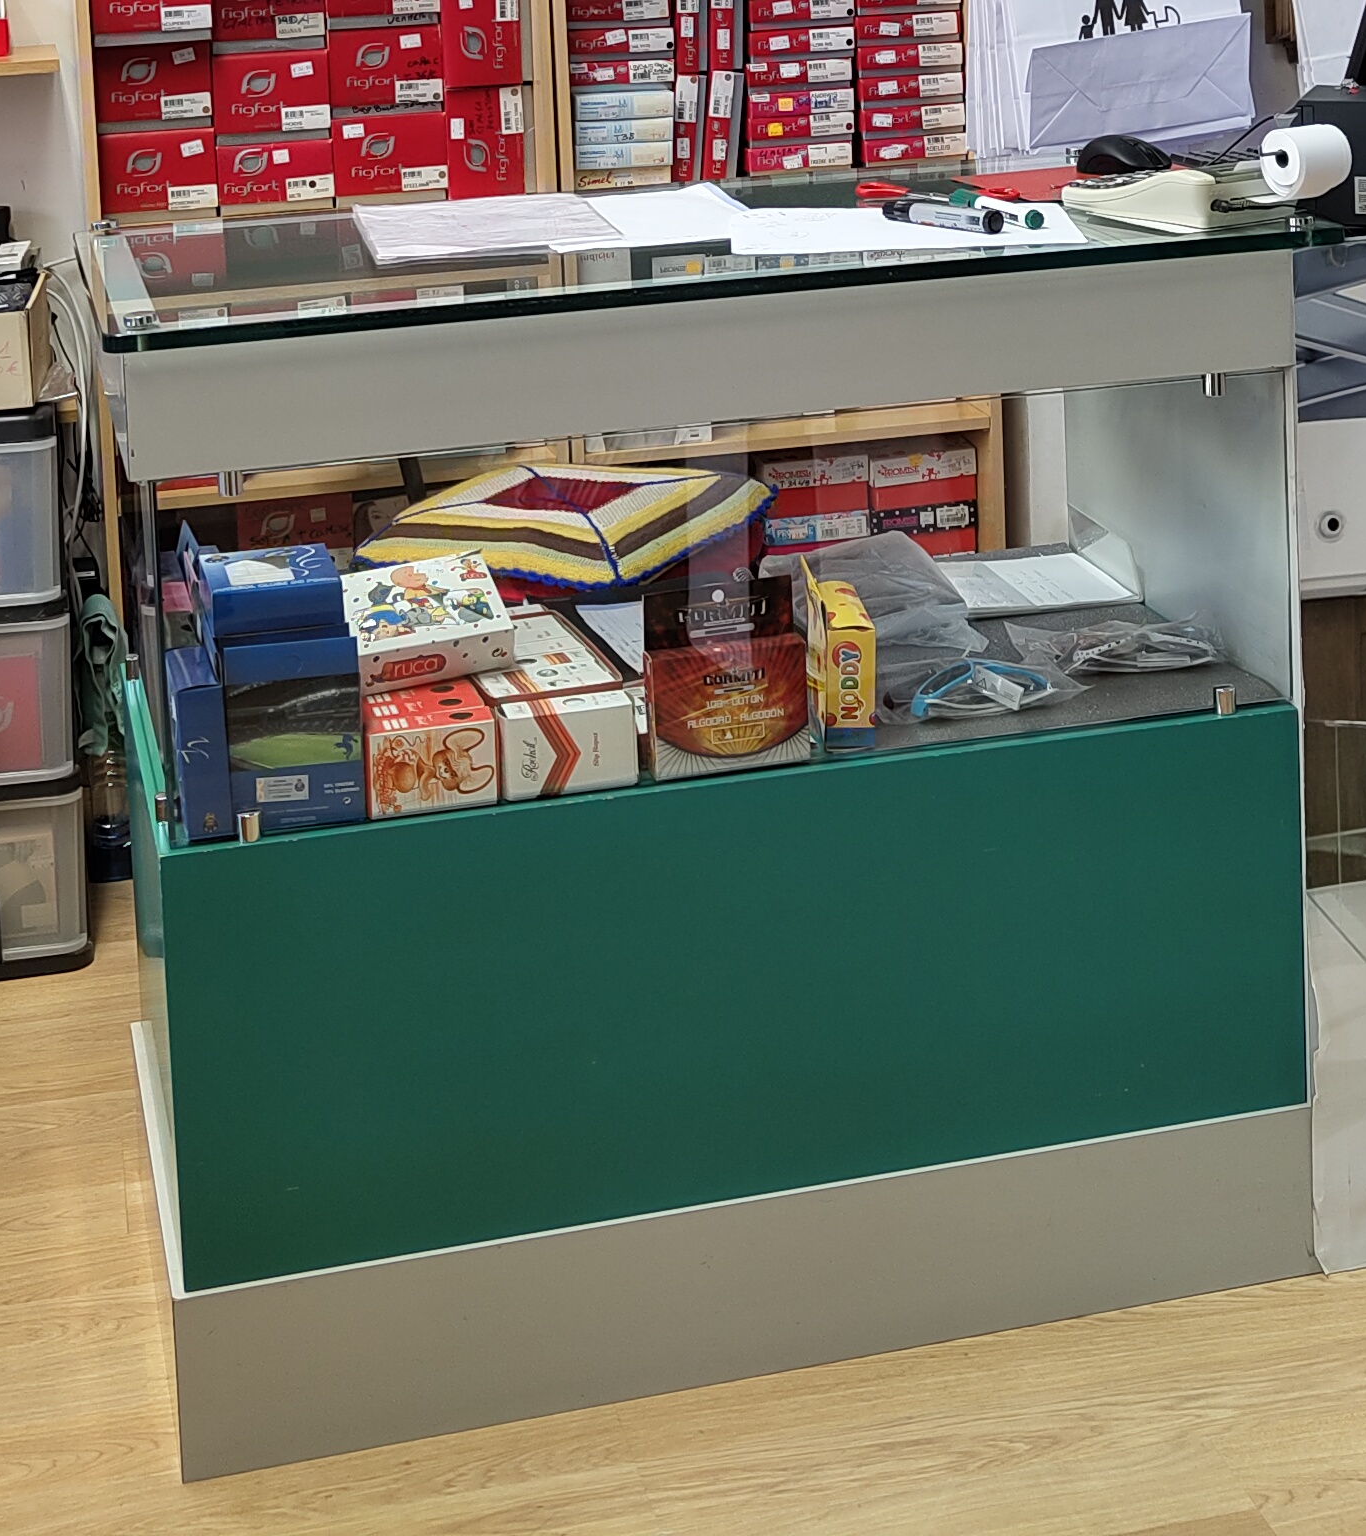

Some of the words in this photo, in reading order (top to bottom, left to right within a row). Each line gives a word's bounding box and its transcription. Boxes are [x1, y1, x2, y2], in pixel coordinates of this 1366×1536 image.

[223, 180, 280, 197] figfort
[392, 656, 440, 678] ruca
[838, 647, 861, 721] NODDY
